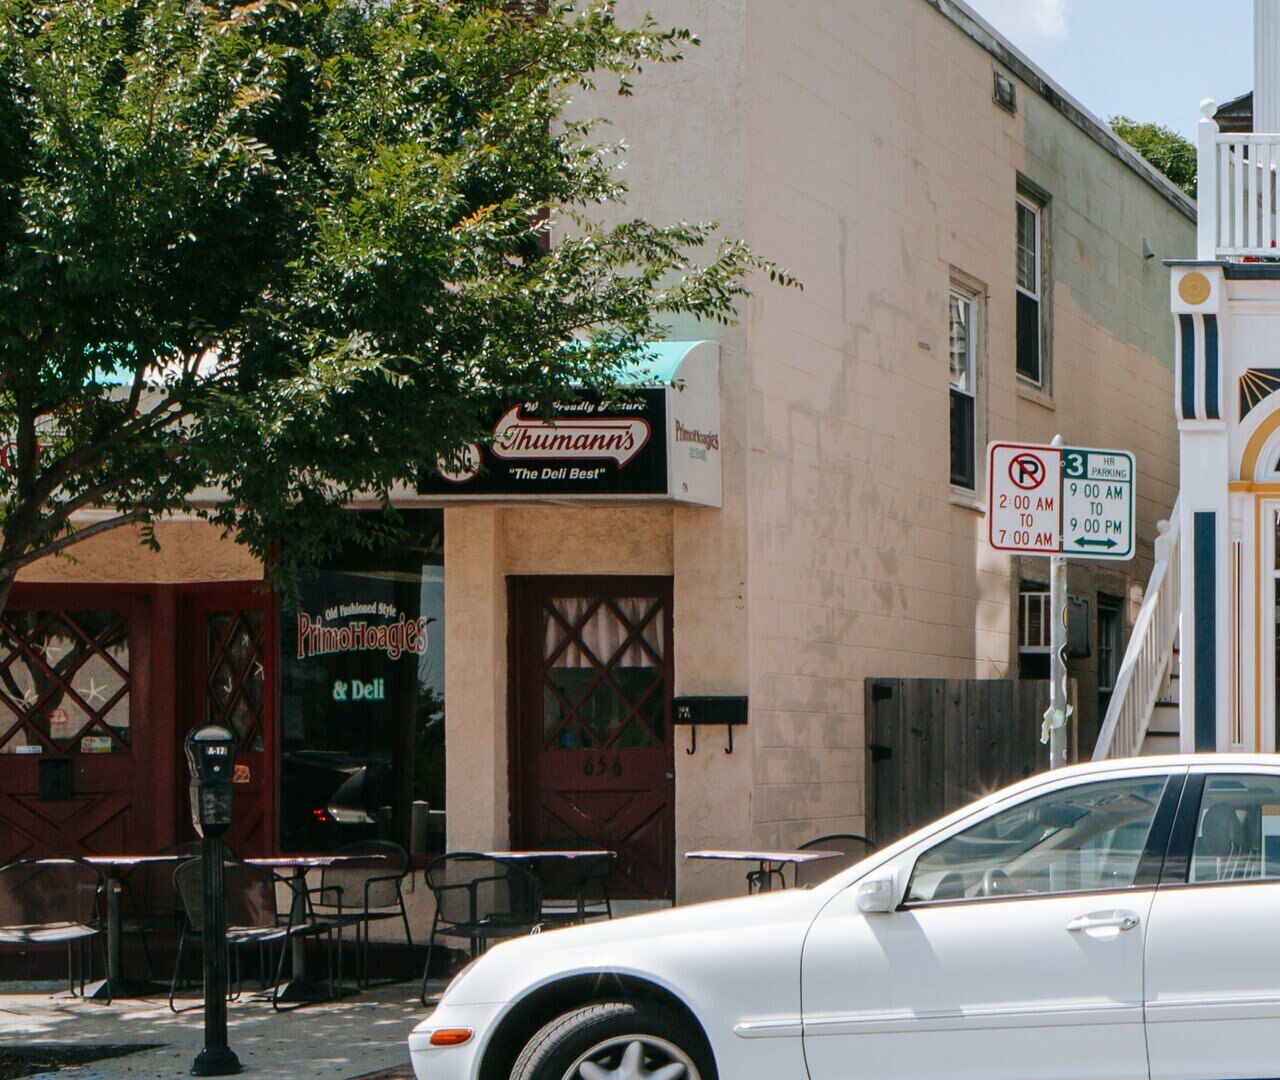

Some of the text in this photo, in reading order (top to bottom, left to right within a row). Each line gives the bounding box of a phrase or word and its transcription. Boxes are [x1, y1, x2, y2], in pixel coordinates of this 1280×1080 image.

[501, 423, 635, 452] Thumann's
[508, 467, 606, 480] "The Deli Best"
[1066, 453, 1115, 477] 3 HR
[1091, 468, 1127, 478] PARKING
[1070, 482, 1123, 500] 9:00 AM
[999, 494, 1054, 512] 2:00 AM
[1089, 501, 1103, 516] TO
[1020, 513, 1033, 528] TO
[1070, 518, 1122, 535] 9:00 PM
[999, 529, 1053, 547] 7:00 AM
[325, 606, 338, 620] Old
[378, 602, 397, 618] Style
[297, 612, 429, 660] PrimoHoagies
[333, 678, 385, 700] & Deli
[583, 756, 622, 776] 656
